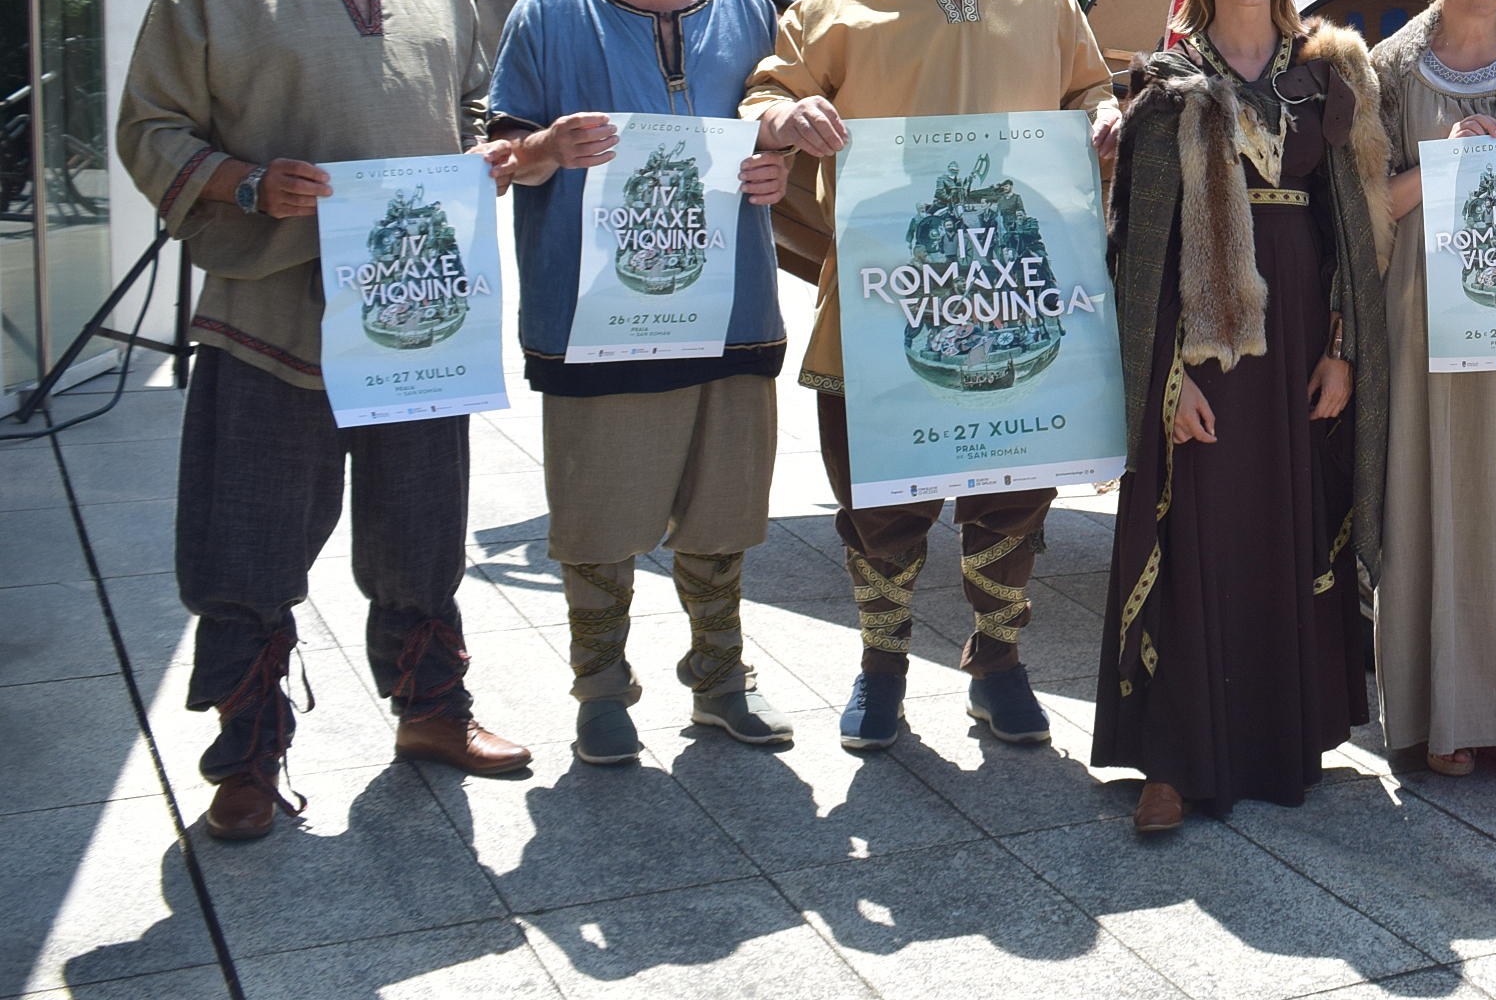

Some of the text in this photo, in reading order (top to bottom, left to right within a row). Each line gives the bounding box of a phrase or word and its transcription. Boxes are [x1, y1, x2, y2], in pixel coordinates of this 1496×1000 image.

[640, 124, 681, 132] VICEDO
[695, 126, 724, 135] LUGO
[895, 129, 1045, 145] O VICEDO LUGO
[370, 169, 414, 178] VICEDO
[428, 165, 459, 175] LUGO
[653, 186, 677, 206] IV
[594, 208, 702, 232] ROMAXE
[400, 235, 426, 257] IV
[616, 229, 725, 250] VIQUINGA
[957, 227, 995, 259] IV
[336, 255, 459, 291] ROMAXE
[861, 257, 1045, 303] ROMAXE
[362, 273, 491, 306] VIQUINGA
[899, 286, 1095, 328] VIQUINGA
[609, 313, 697, 325] 26 27 XULLO
[1465, 330, 1482, 339] 26
[366, 376, 385, 386] 26
[393, 372, 410, 383] 27
[416, 365, 467, 380] XULLO
[913, 428, 939, 444] 26
[954, 423, 980, 440] 27
[989, 414, 1066, 436] XULLO
[956, 444, 986, 453] PRAIA
[968, 451, 987, 459] SAN
[990, 448, 1027, 457] ROMÁN
